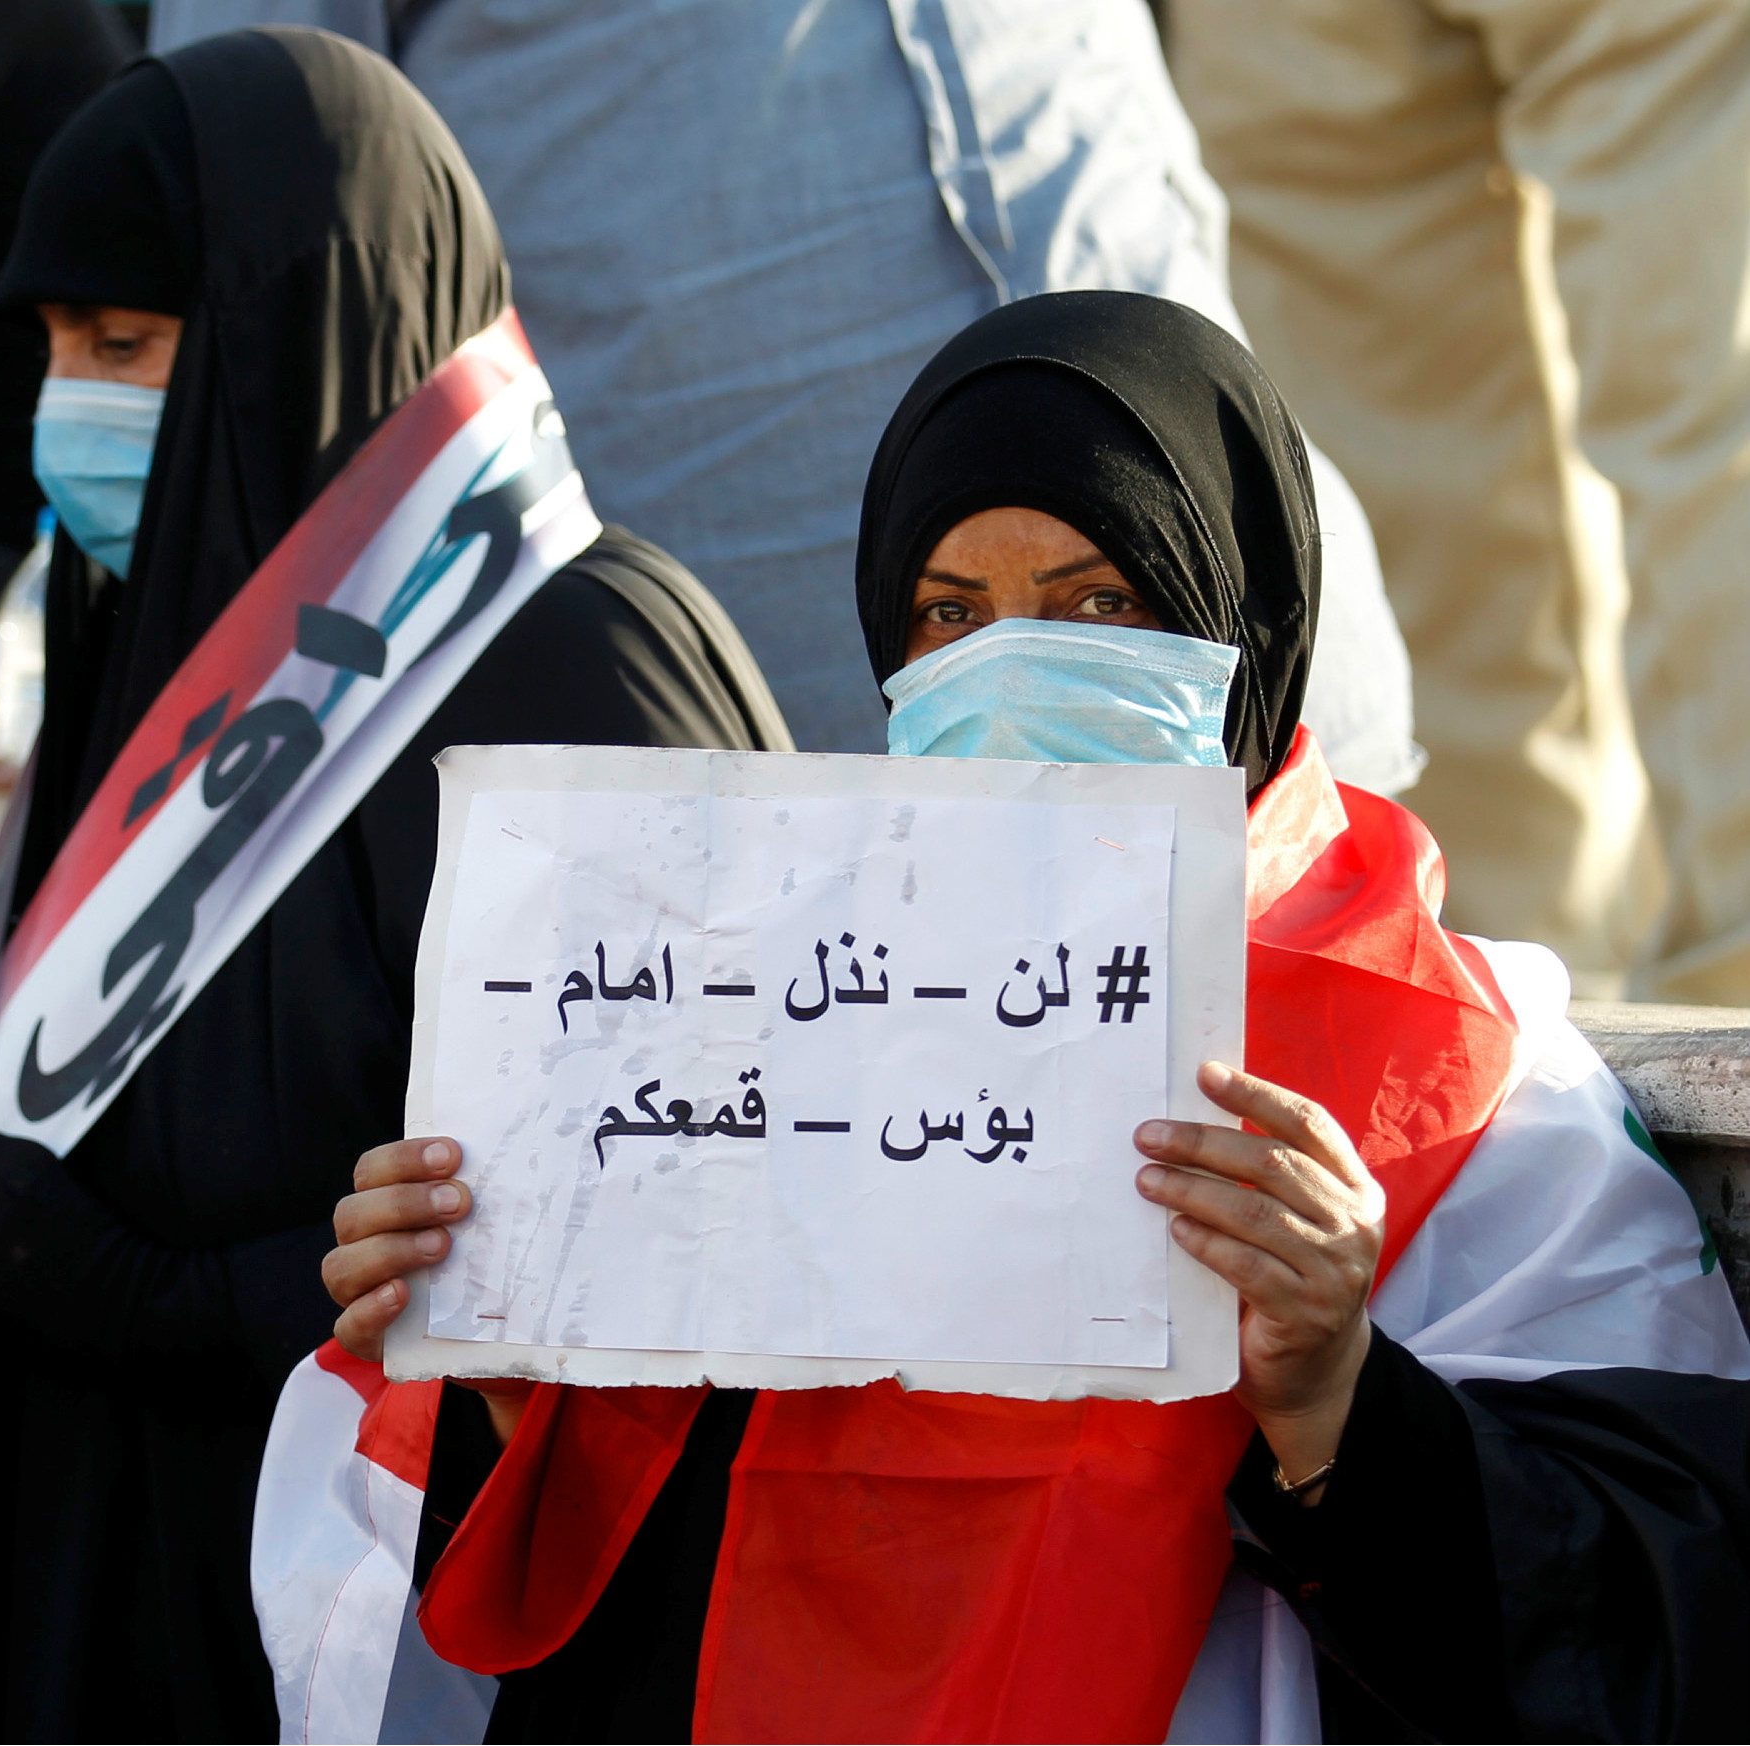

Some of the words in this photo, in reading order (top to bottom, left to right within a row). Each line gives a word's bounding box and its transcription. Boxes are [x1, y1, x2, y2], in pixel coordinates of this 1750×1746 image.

[556, 939, 675, 1035] امام
[784, 931, 889, 1022] نذل
[995, 942, 1071, 1028] لن
[1096, 945, 1150, 1024] #
[592, 1066, 767, 1171] قمعكم
[880, 1087, 1035, 1164] بؤس
